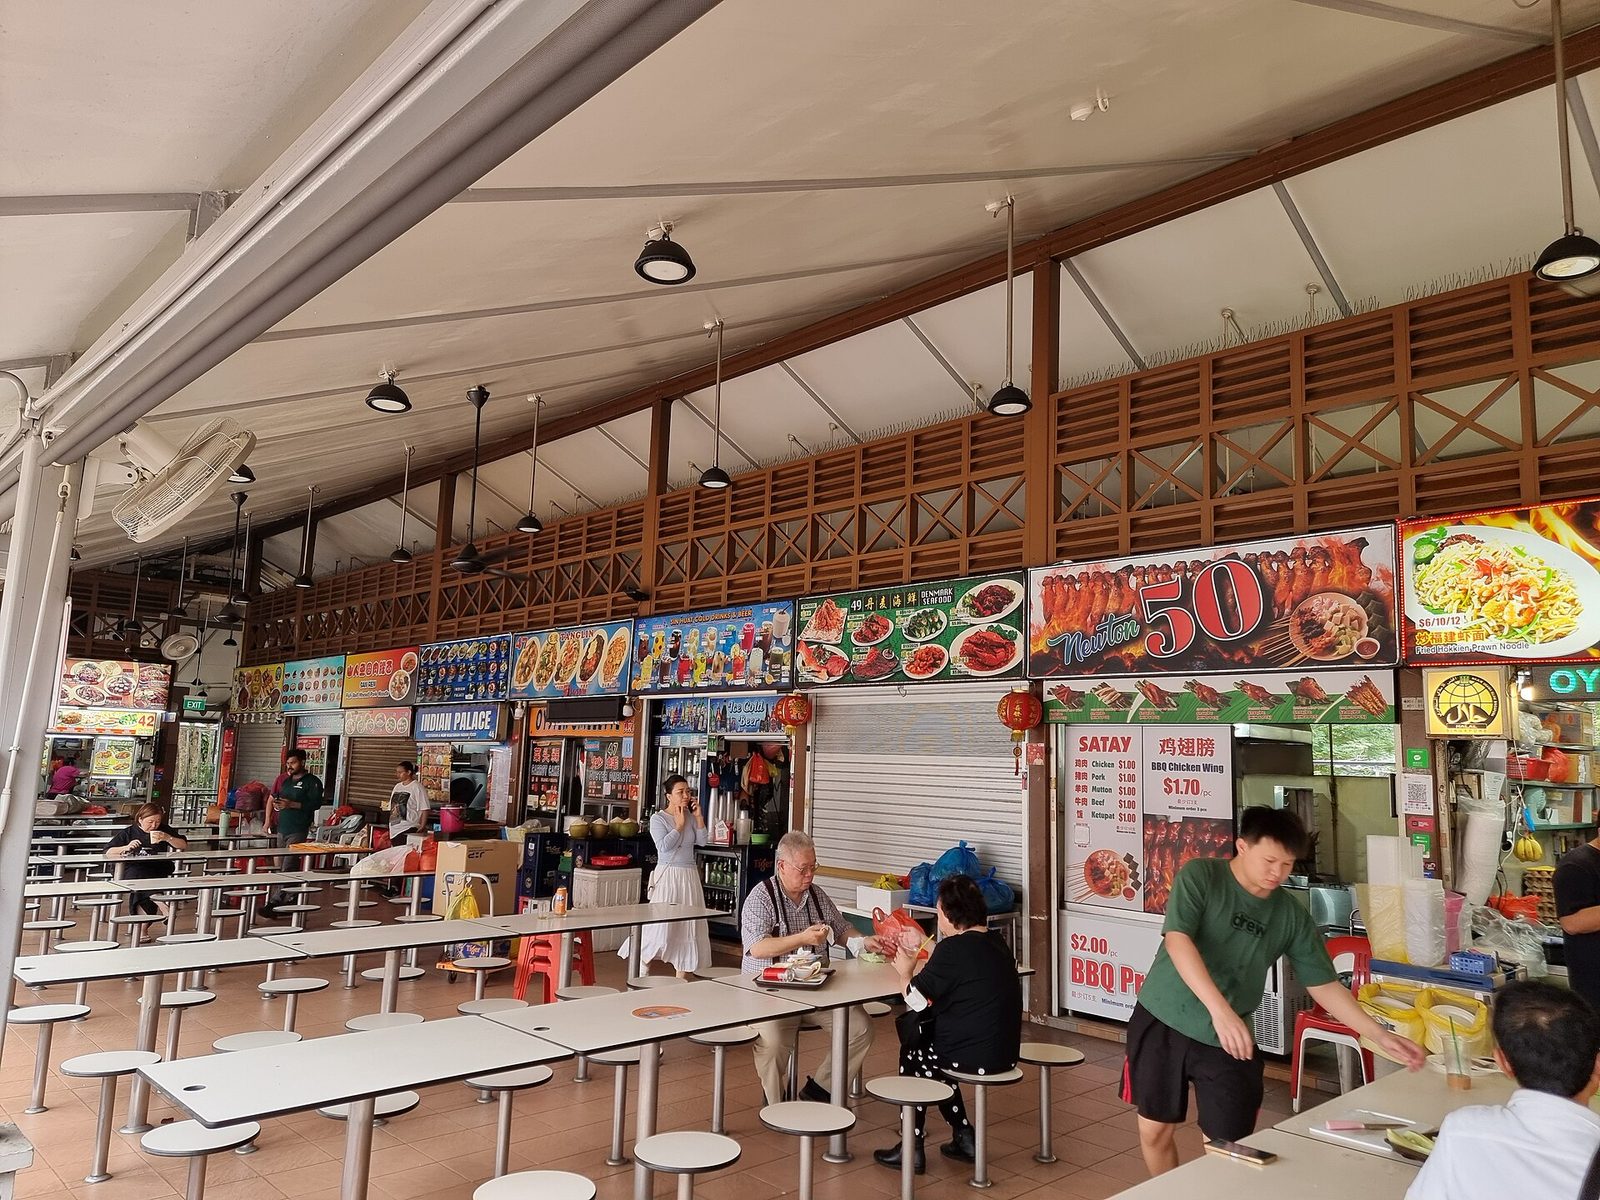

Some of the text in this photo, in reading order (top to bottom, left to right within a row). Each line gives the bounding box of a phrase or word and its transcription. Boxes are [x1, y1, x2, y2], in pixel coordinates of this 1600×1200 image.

[921, 588, 953, 598] DENMARK
[851, 599, 862, 611] 49
[922, 595, 952, 606] SEAFOOD
[694, 614, 710, 624] COLD
[711, 612, 731, 622] DRINKS
[738, 609, 752, 619] BEER
[1046, 558, 1264, 665] Newton 50
[560, 629, 594, 641] TANGLIN
[1415, 630, 1486, 645] 炒福建虾面
[515, 636, 529, 650] 47
[1416, 642, 1530, 655] Fried Hokkien Prawn Noodle
[187, 701, 203, 709] EXIT
[728, 700, 765, 713] Ice Cold
[138, 714, 155, 727] 42
[421, 711, 491, 731] INDIAN PALACE
[738, 716, 760, 727] Beer
[607, 742, 619, 756] 47
[1079, 736, 1132, 753] SATAY
[1159, 737, 1215, 757] 鸡翅膀
[1092, 760, 1115, 768] Chicken
[1118, 760, 1136, 770] $1.00
[1151, 761, 1224, 774] BBQ Chicken Wing
[1092, 773, 1106, 781] Pork
[1118, 773, 1136, 783] $1.00
[1092, 786, 1112, 794] Mutton
[1118, 786, 1136, 796] $1.00
[1075, 797, 1136, 810] 牛肉 Beef $1.00
[1091, 811, 1115, 820] Ketupat
[1118, 813, 1136, 823] $1.00
[753, 858, 773, 872] Tiger
[1231, 912, 1268, 938] drew
[466, 944, 481, 955] Tiger
[1071, 957, 1116, 995] BBQ
[1101, 997, 1125, 1008] Minimum
